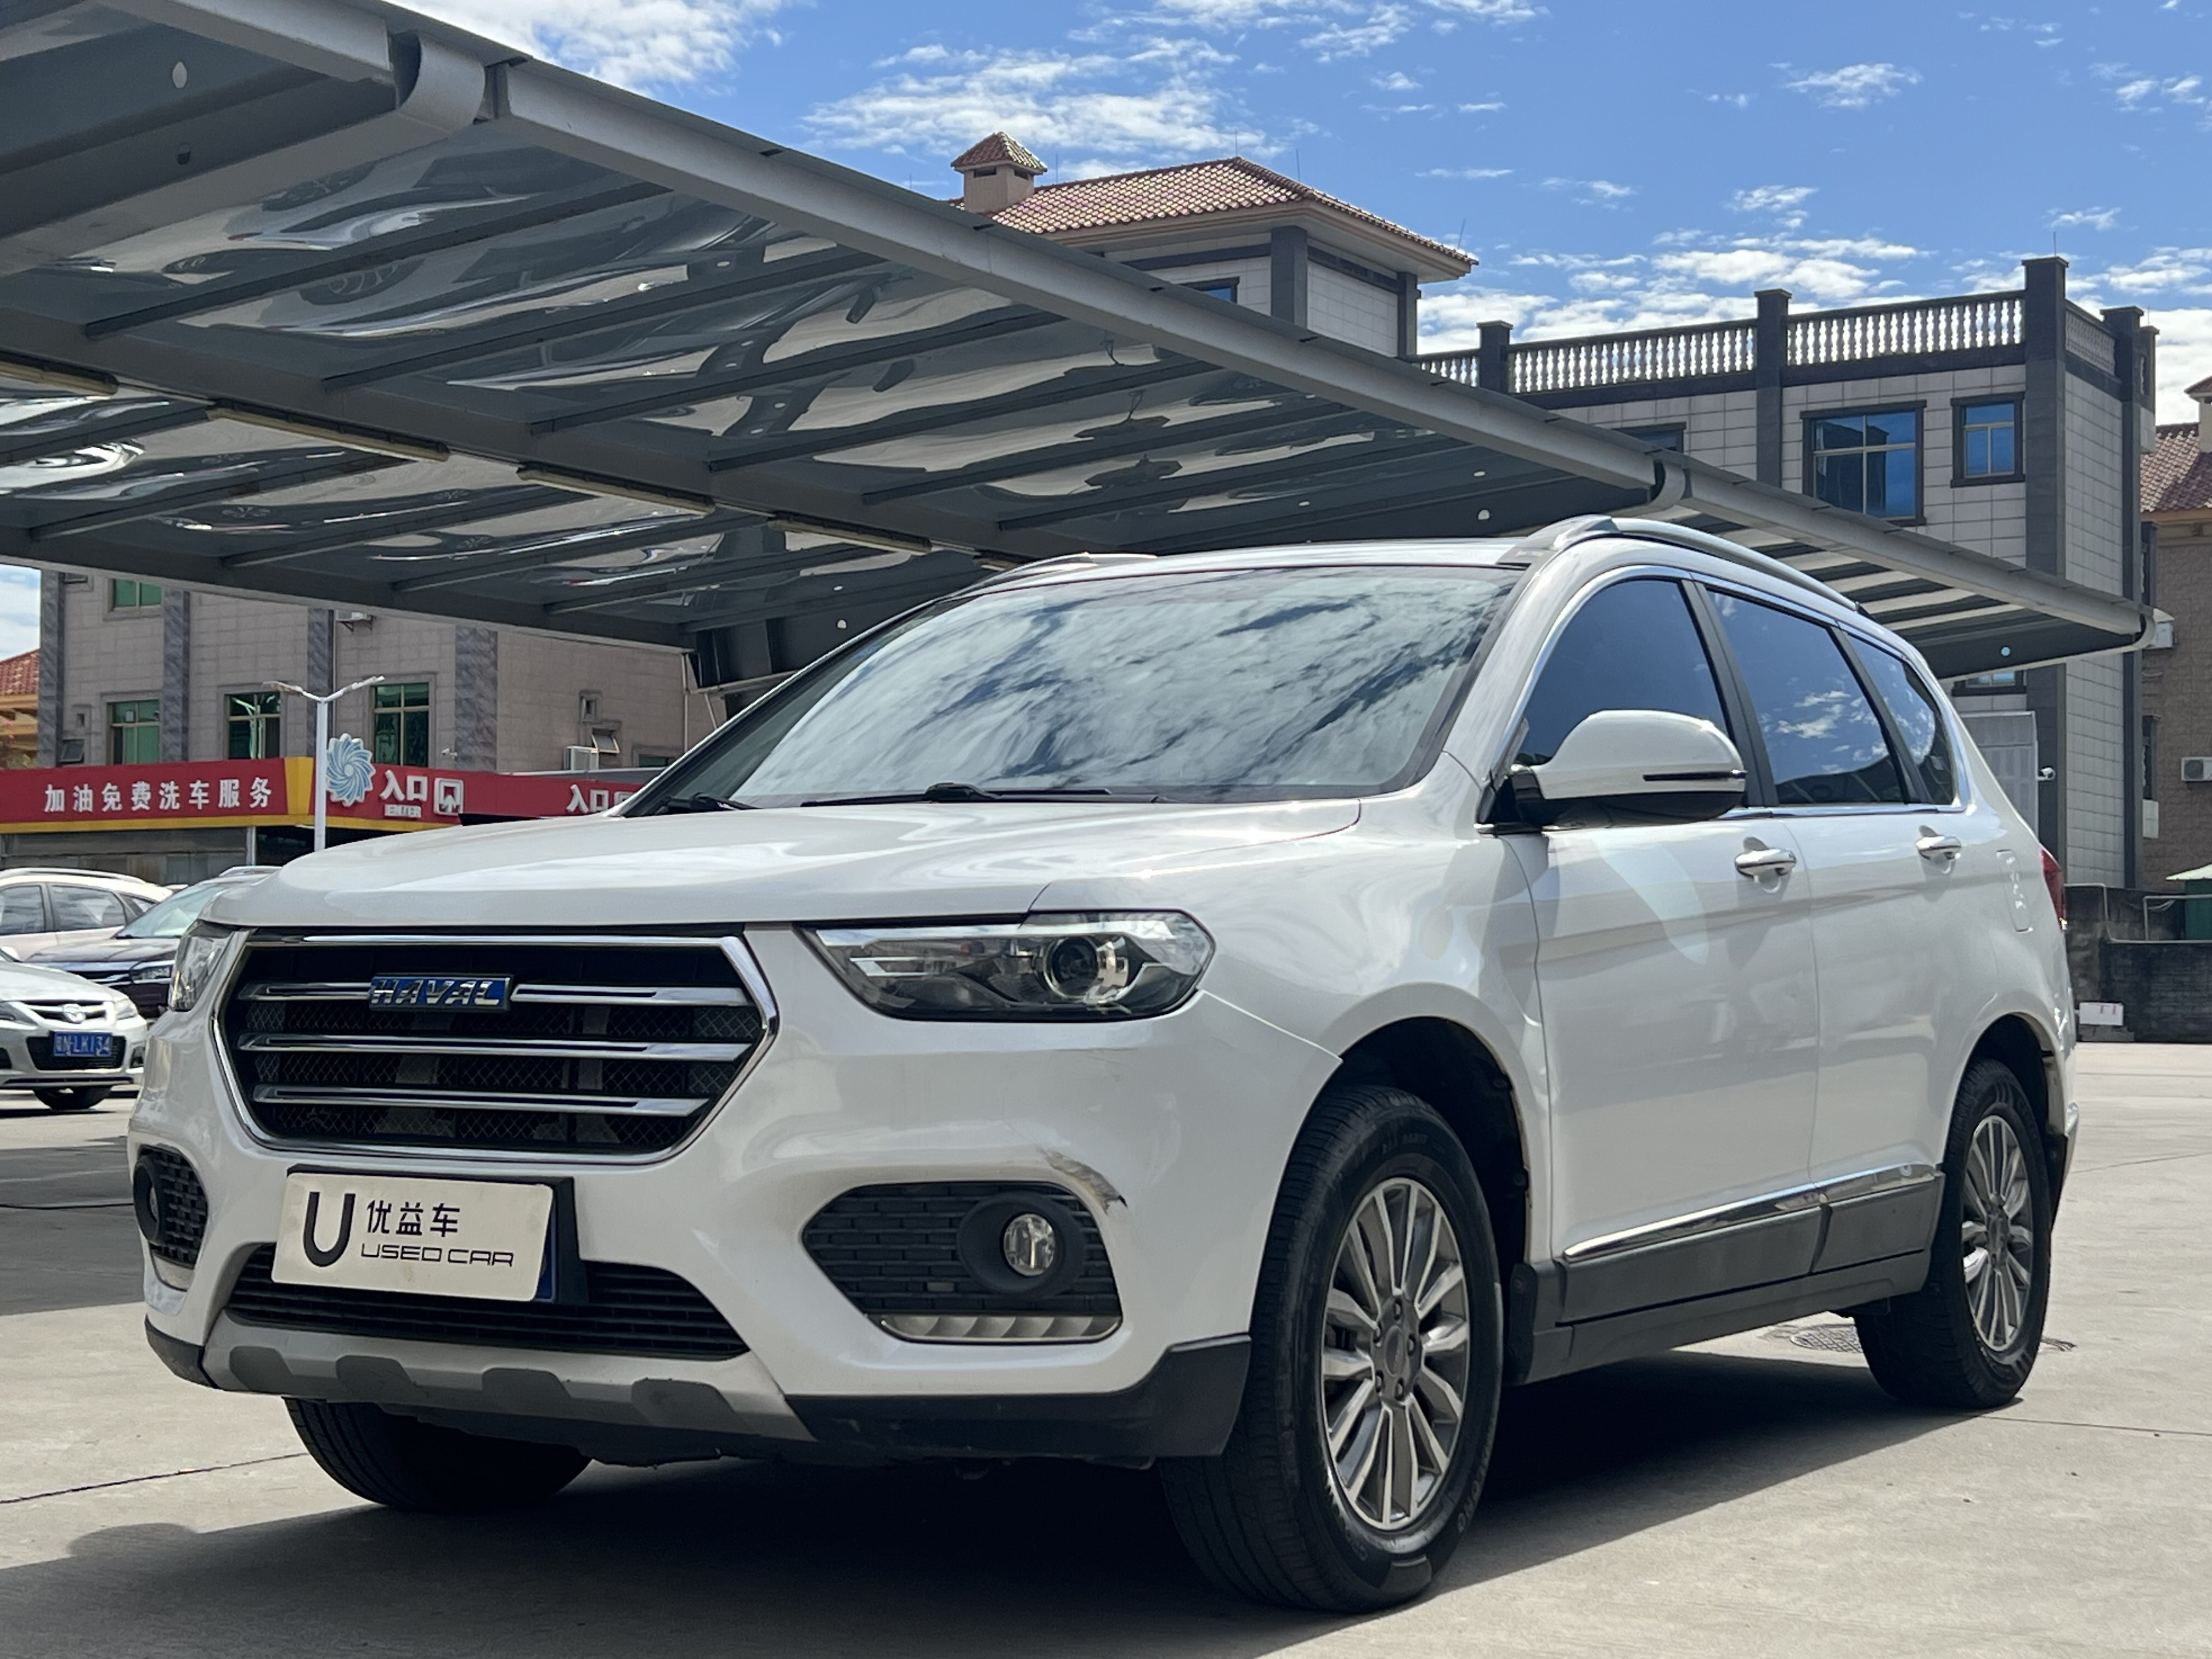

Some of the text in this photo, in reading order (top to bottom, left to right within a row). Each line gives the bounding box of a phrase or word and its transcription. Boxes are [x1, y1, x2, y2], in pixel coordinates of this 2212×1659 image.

[44, 777, 273, 813] 加油免费洗车服务
[380, 769, 428, 802] 入口
[566, 783, 610, 814] 入口
[371, 979, 500, 1005] HAVAL
[366, 1199, 460, 1238] 优益车
[360, 1243, 514, 1267] USED CAR
